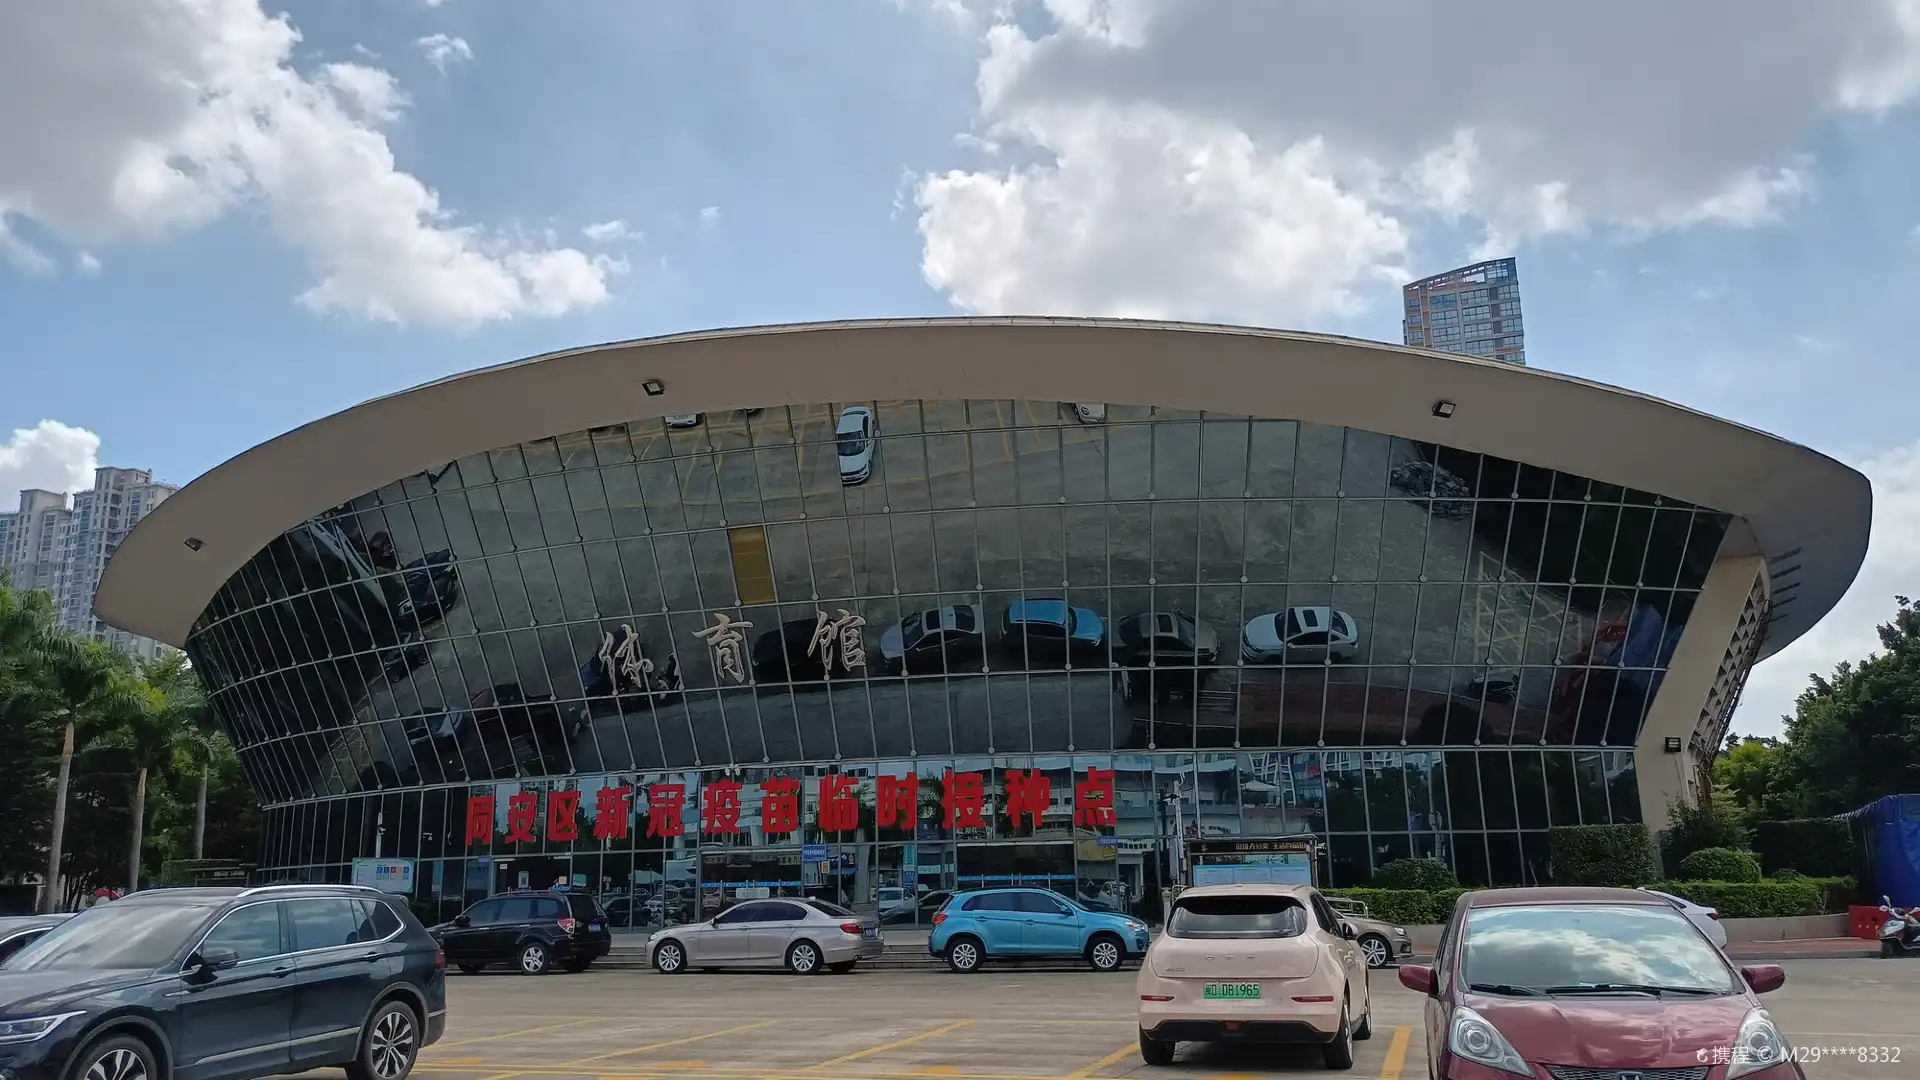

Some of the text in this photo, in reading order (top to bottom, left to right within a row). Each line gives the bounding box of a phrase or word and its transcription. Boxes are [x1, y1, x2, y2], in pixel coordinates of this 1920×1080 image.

[598, 608, 868, 688] 体育馆
[465, 766, 1117, 846] 同安区新冠疫苗临时接种点
